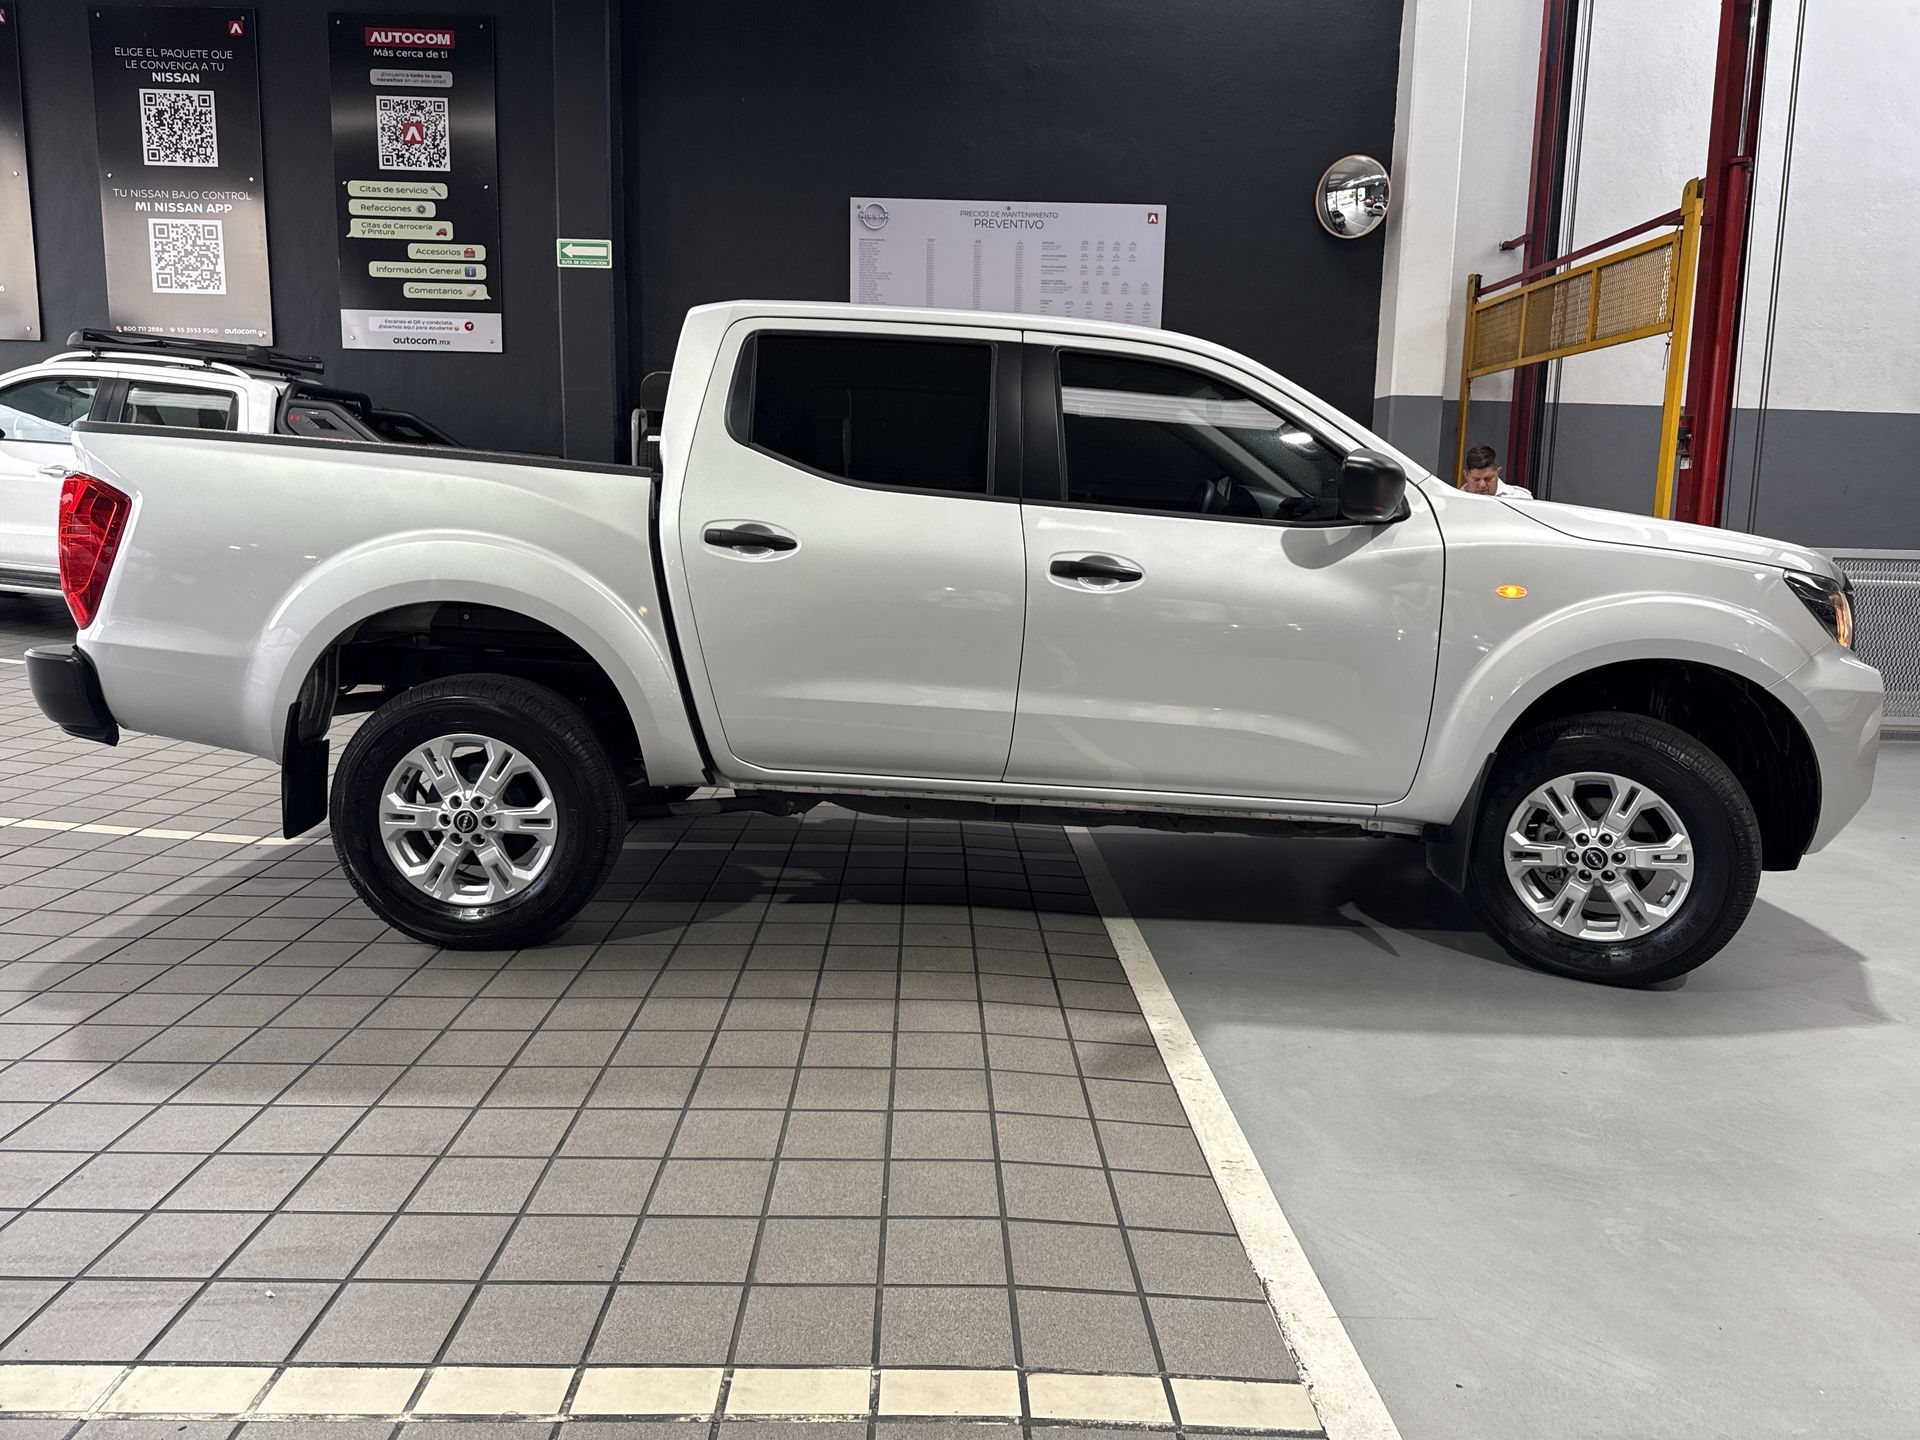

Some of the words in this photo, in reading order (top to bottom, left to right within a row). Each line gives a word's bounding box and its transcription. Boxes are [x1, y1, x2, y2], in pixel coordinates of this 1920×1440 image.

[370, 31, 451, 45] AUTOCOM
[114, 47, 143, 57] ELIGE
[146, 48, 158, 58] EL
[161, 49, 208, 59] PAQUETE
[211, 50, 233, 60] QUE
[373, 48, 394, 57] Más
[396, 50, 423, 58] cerca
[426, 50, 438, 58] de
[441, 50, 448, 59] ti
[125, 60, 138, 69] LE
[140, 61, 199, 71] CONVENGA
[201, 62, 209, 71] A
[210, 62, 225, 72] TU
[152, 72, 200, 83] NISSAN
[112, 188, 128, 197] TU
[130, 189, 169, 199] NISSAN
[172, 190, 199, 199] BAJO
[201, 191, 253, 201] CONTROL
[360, 185, 381, 193] Citas
[135, 202, 151, 211] MI
[154, 202, 203, 213] NISSAN
[206, 203, 233, 213] APP
[360, 204, 412, 212] Refacciones
[960, 210, 989, 218] PRECIOS
[1002, 211, 1059, 219] MANTENIMIENTO
[974, 218, 1045, 230] PREVENTIVO
[415, 248, 461, 256] Accesorios
[376, 266, 427, 274] Información
[429, 267, 461, 275] General
[408, 287, 463, 295] Comentarios
[393, 336, 451, 346] autocom.mx
